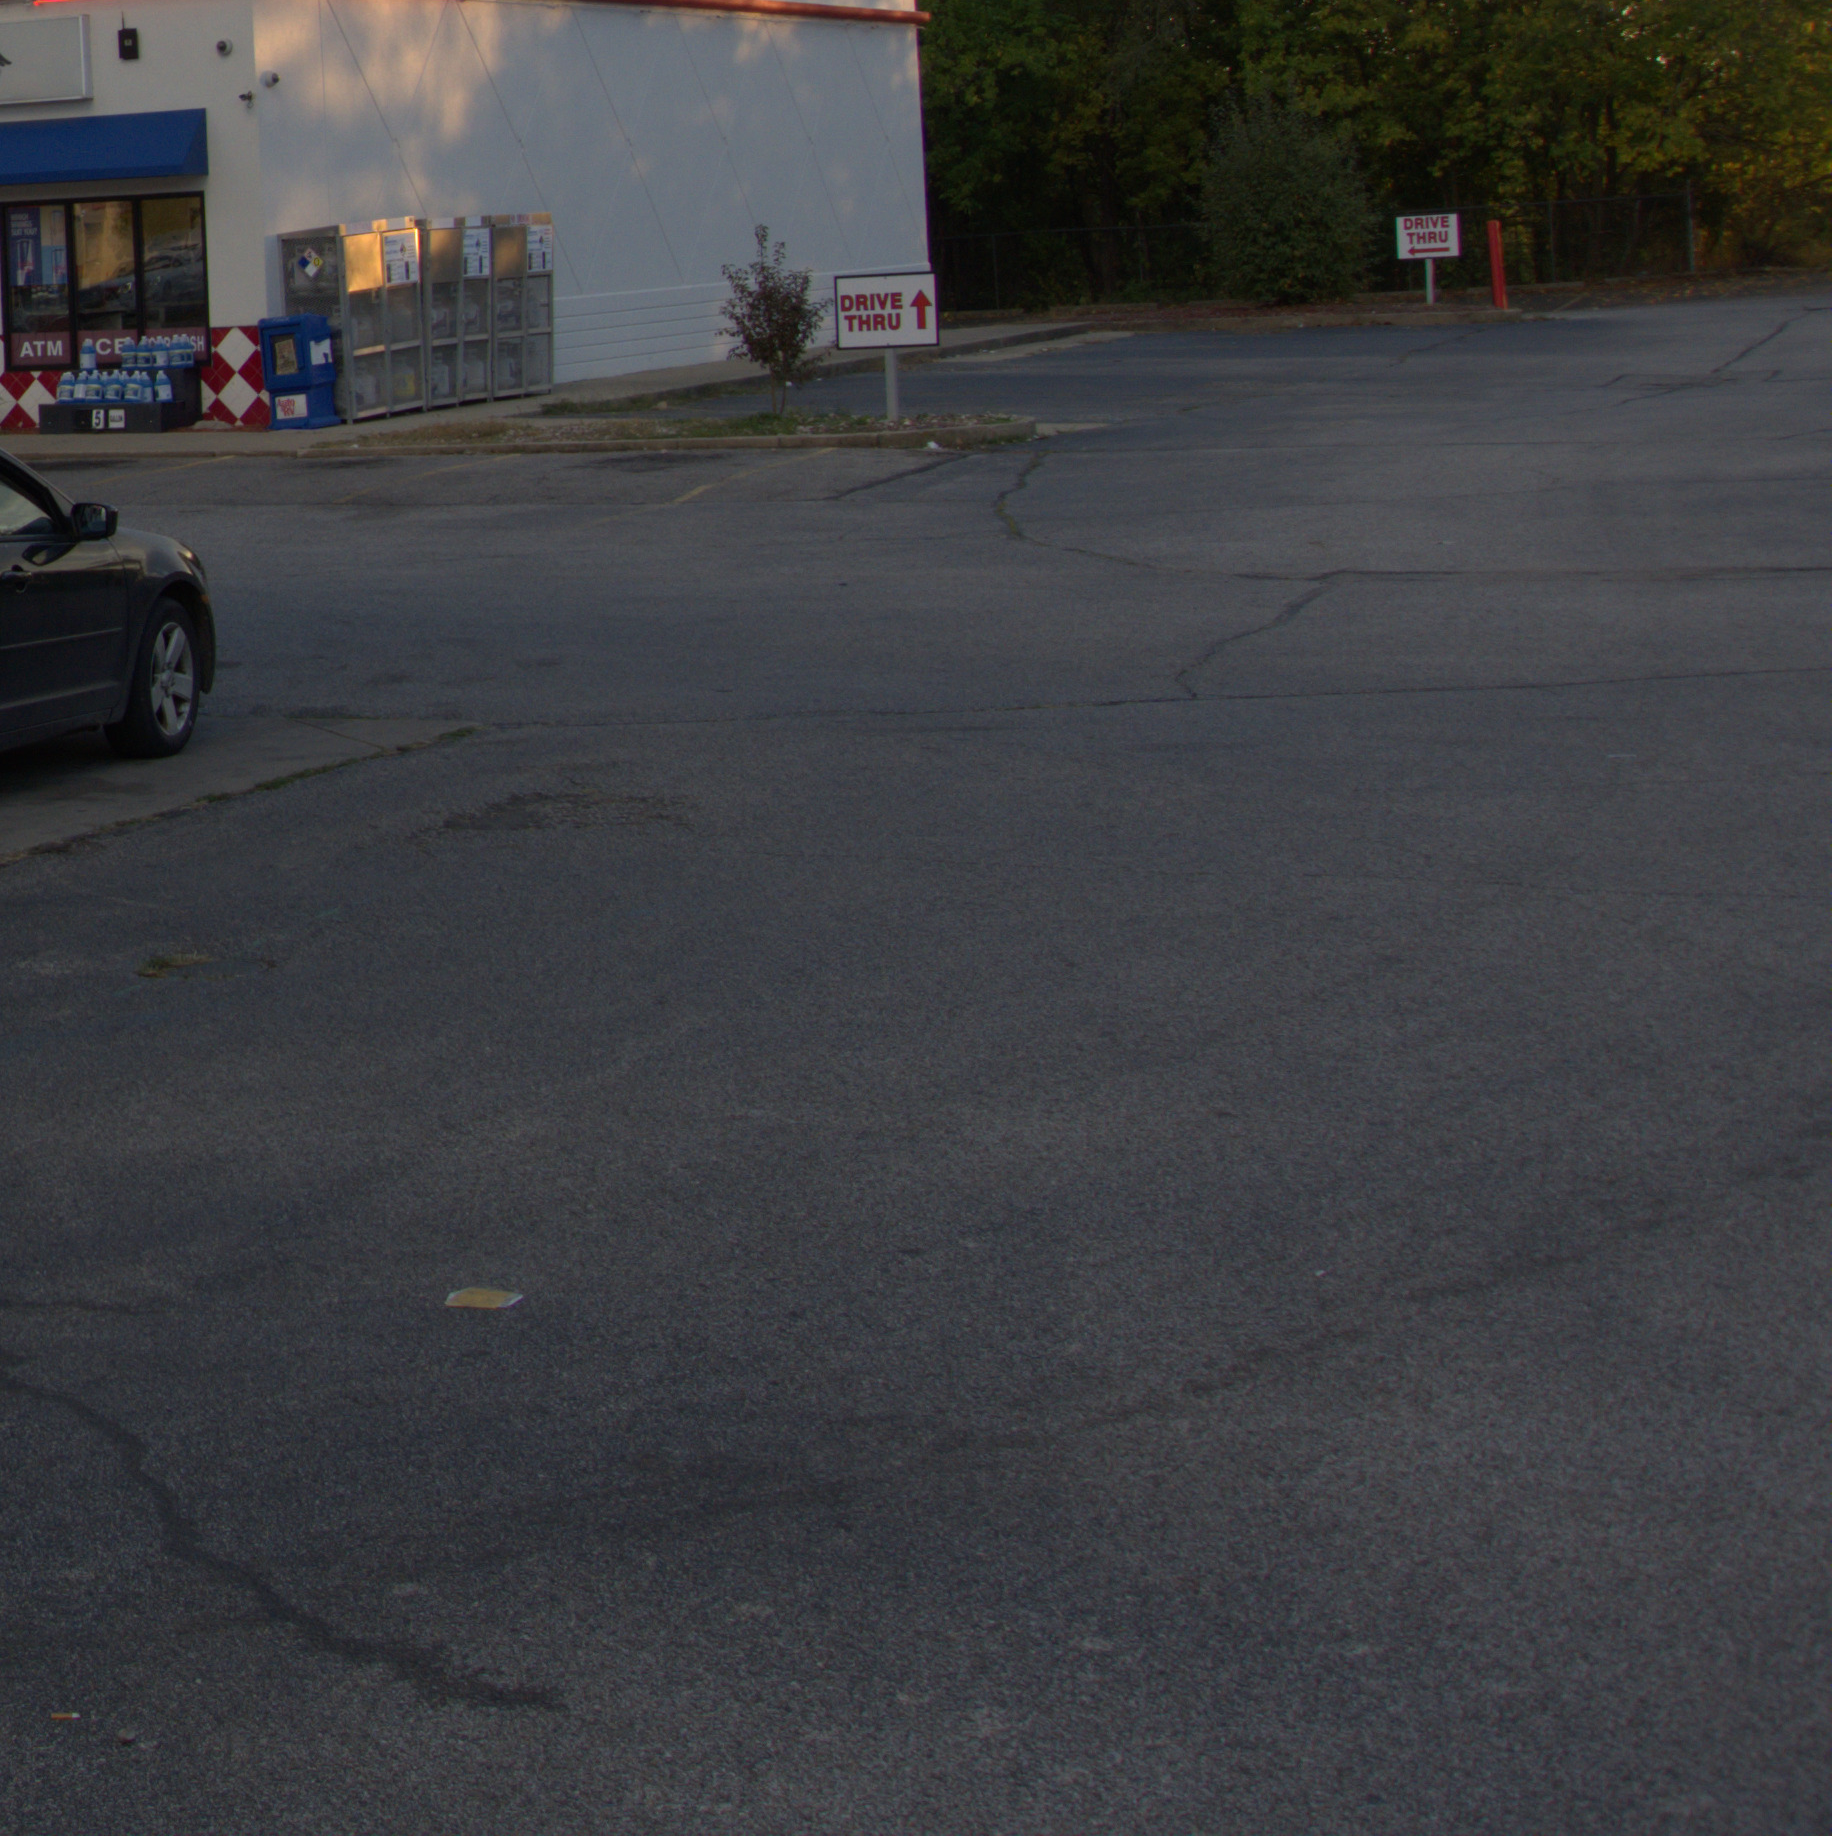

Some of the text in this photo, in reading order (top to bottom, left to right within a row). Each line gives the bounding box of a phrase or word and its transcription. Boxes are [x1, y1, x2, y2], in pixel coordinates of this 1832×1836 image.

[1404, 216, 1450, 230] DRIVE
[1407, 231, 1448, 244] THRU
[841, 293, 903, 311] DRIVE
[844, 313, 900, 332] THRU
[20, 340, 63, 357] ATM
